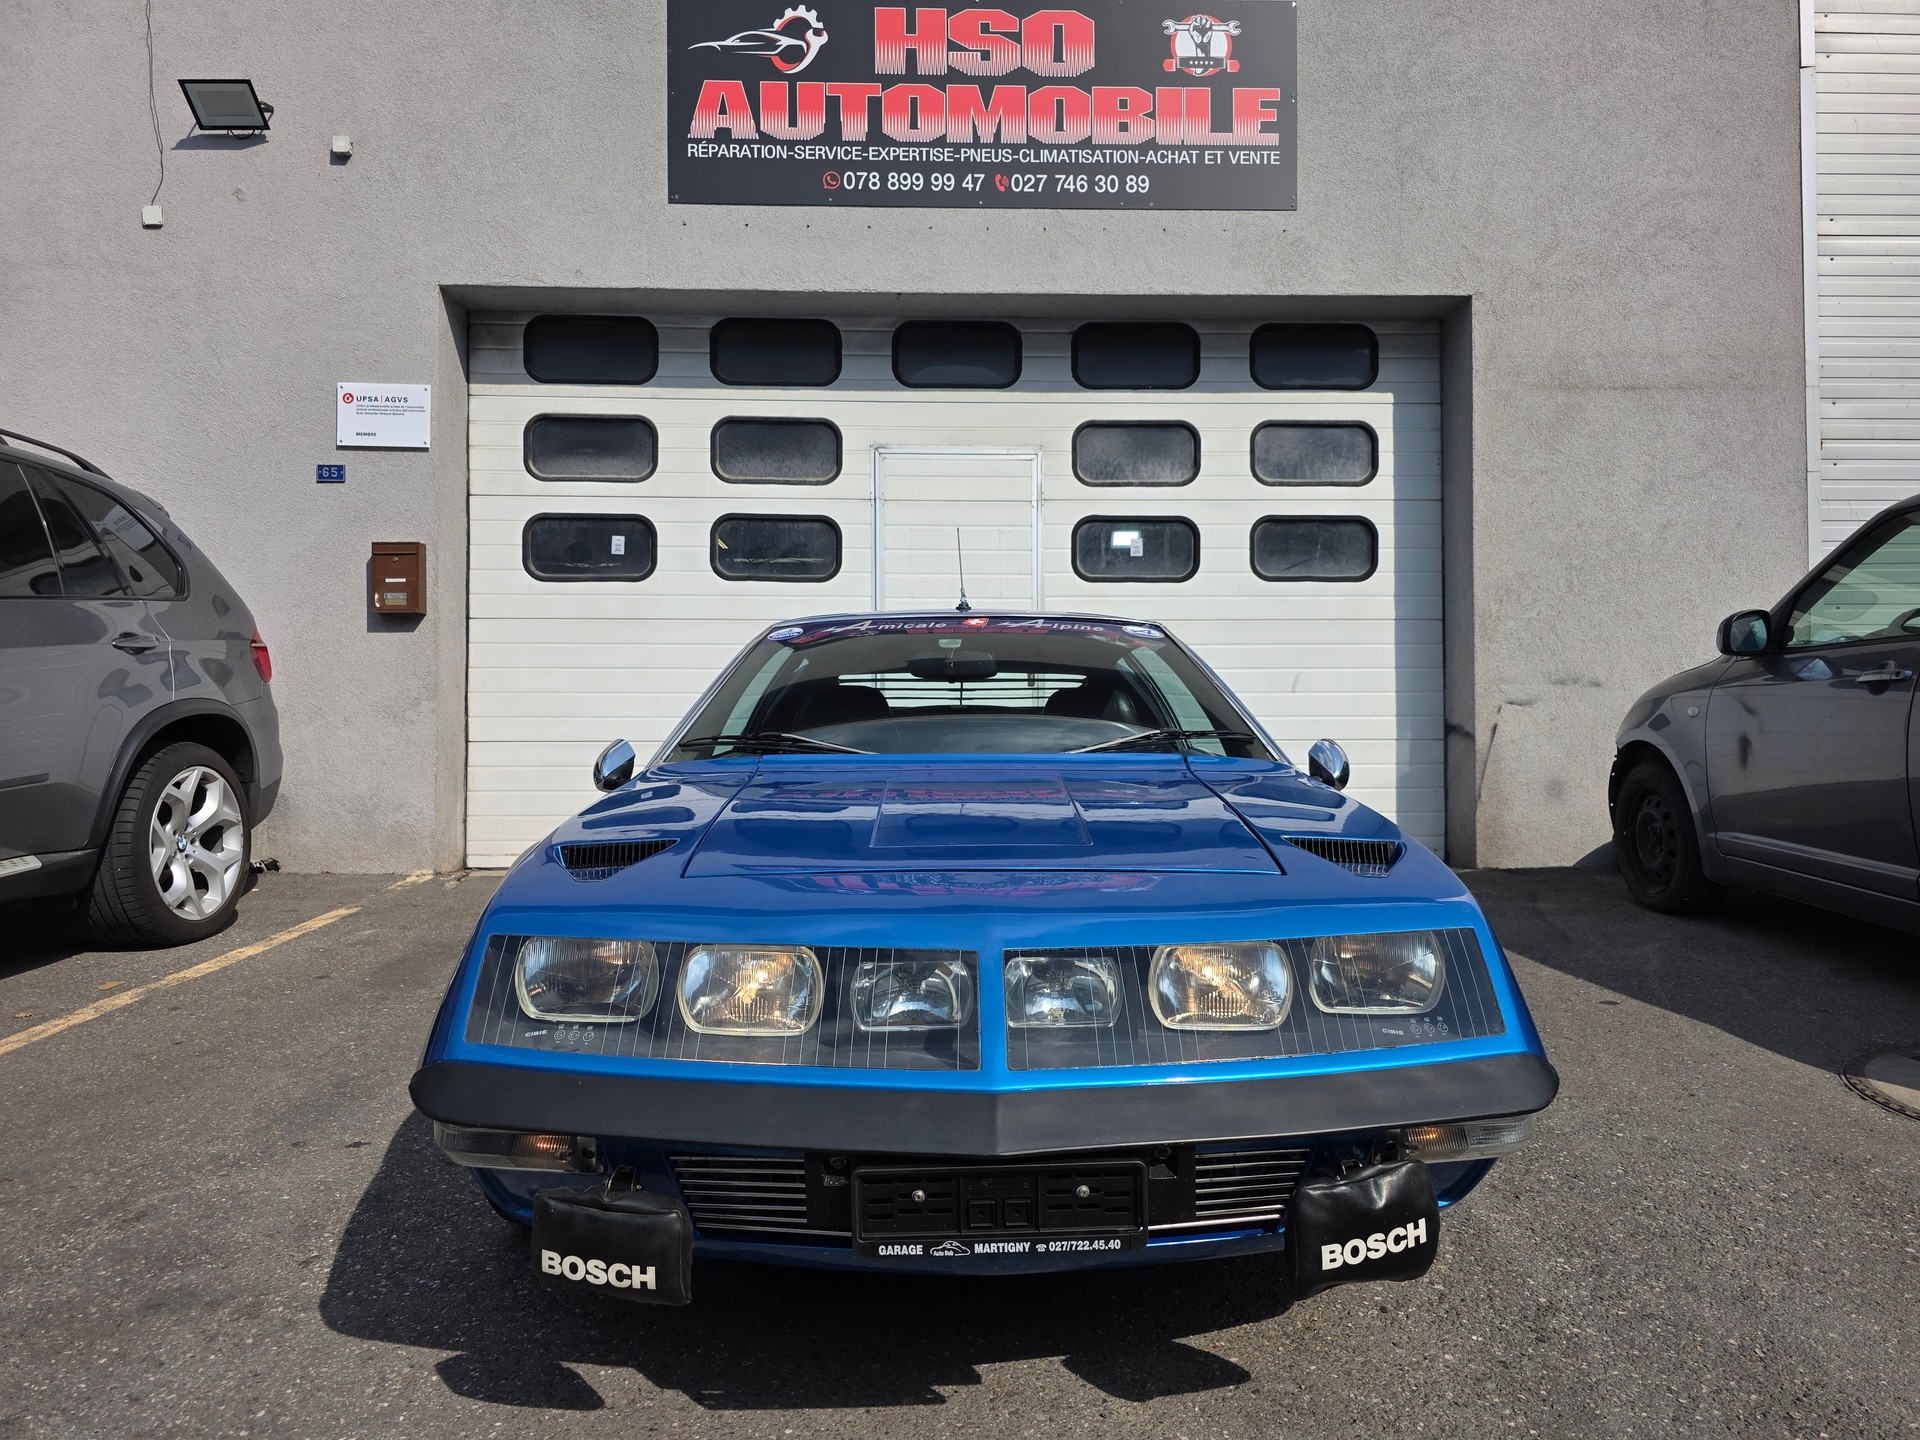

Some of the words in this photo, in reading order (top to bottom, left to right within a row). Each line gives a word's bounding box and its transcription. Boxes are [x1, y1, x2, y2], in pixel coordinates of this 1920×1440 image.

[874, 7, 1095, 77] HSO
[687, 80, 1281, 147] AUTOMOBILE
[1204, 151, 1224, 165] ET
[1230, 151, 1281, 165] VENTE
[842, 171, 881, 190] 078
[886, 172, 924, 191] 899
[930, 173, 955, 191] 99
[961, 173, 986, 192] 47
[1010, 173, 1048, 192] 027
[1054, 174, 1088, 193] 746
[1094, 174, 1119, 193] 30
[1125, 175, 1150, 193] 89
[356, 395, 379, 403] UPSA
[384, 396, 409, 404] AGVS
[322, 467, 338, 478] 65
[878, 1244, 924, 1256] GARAGE
[974, 1242, 1031, 1254] MARTIGNY
[1048, 1239, 1121, 1252] 027/722.45.40
[1321, 1217, 1427, 1271] BOSCH
[541, 1248, 657, 1290] BOSCH
